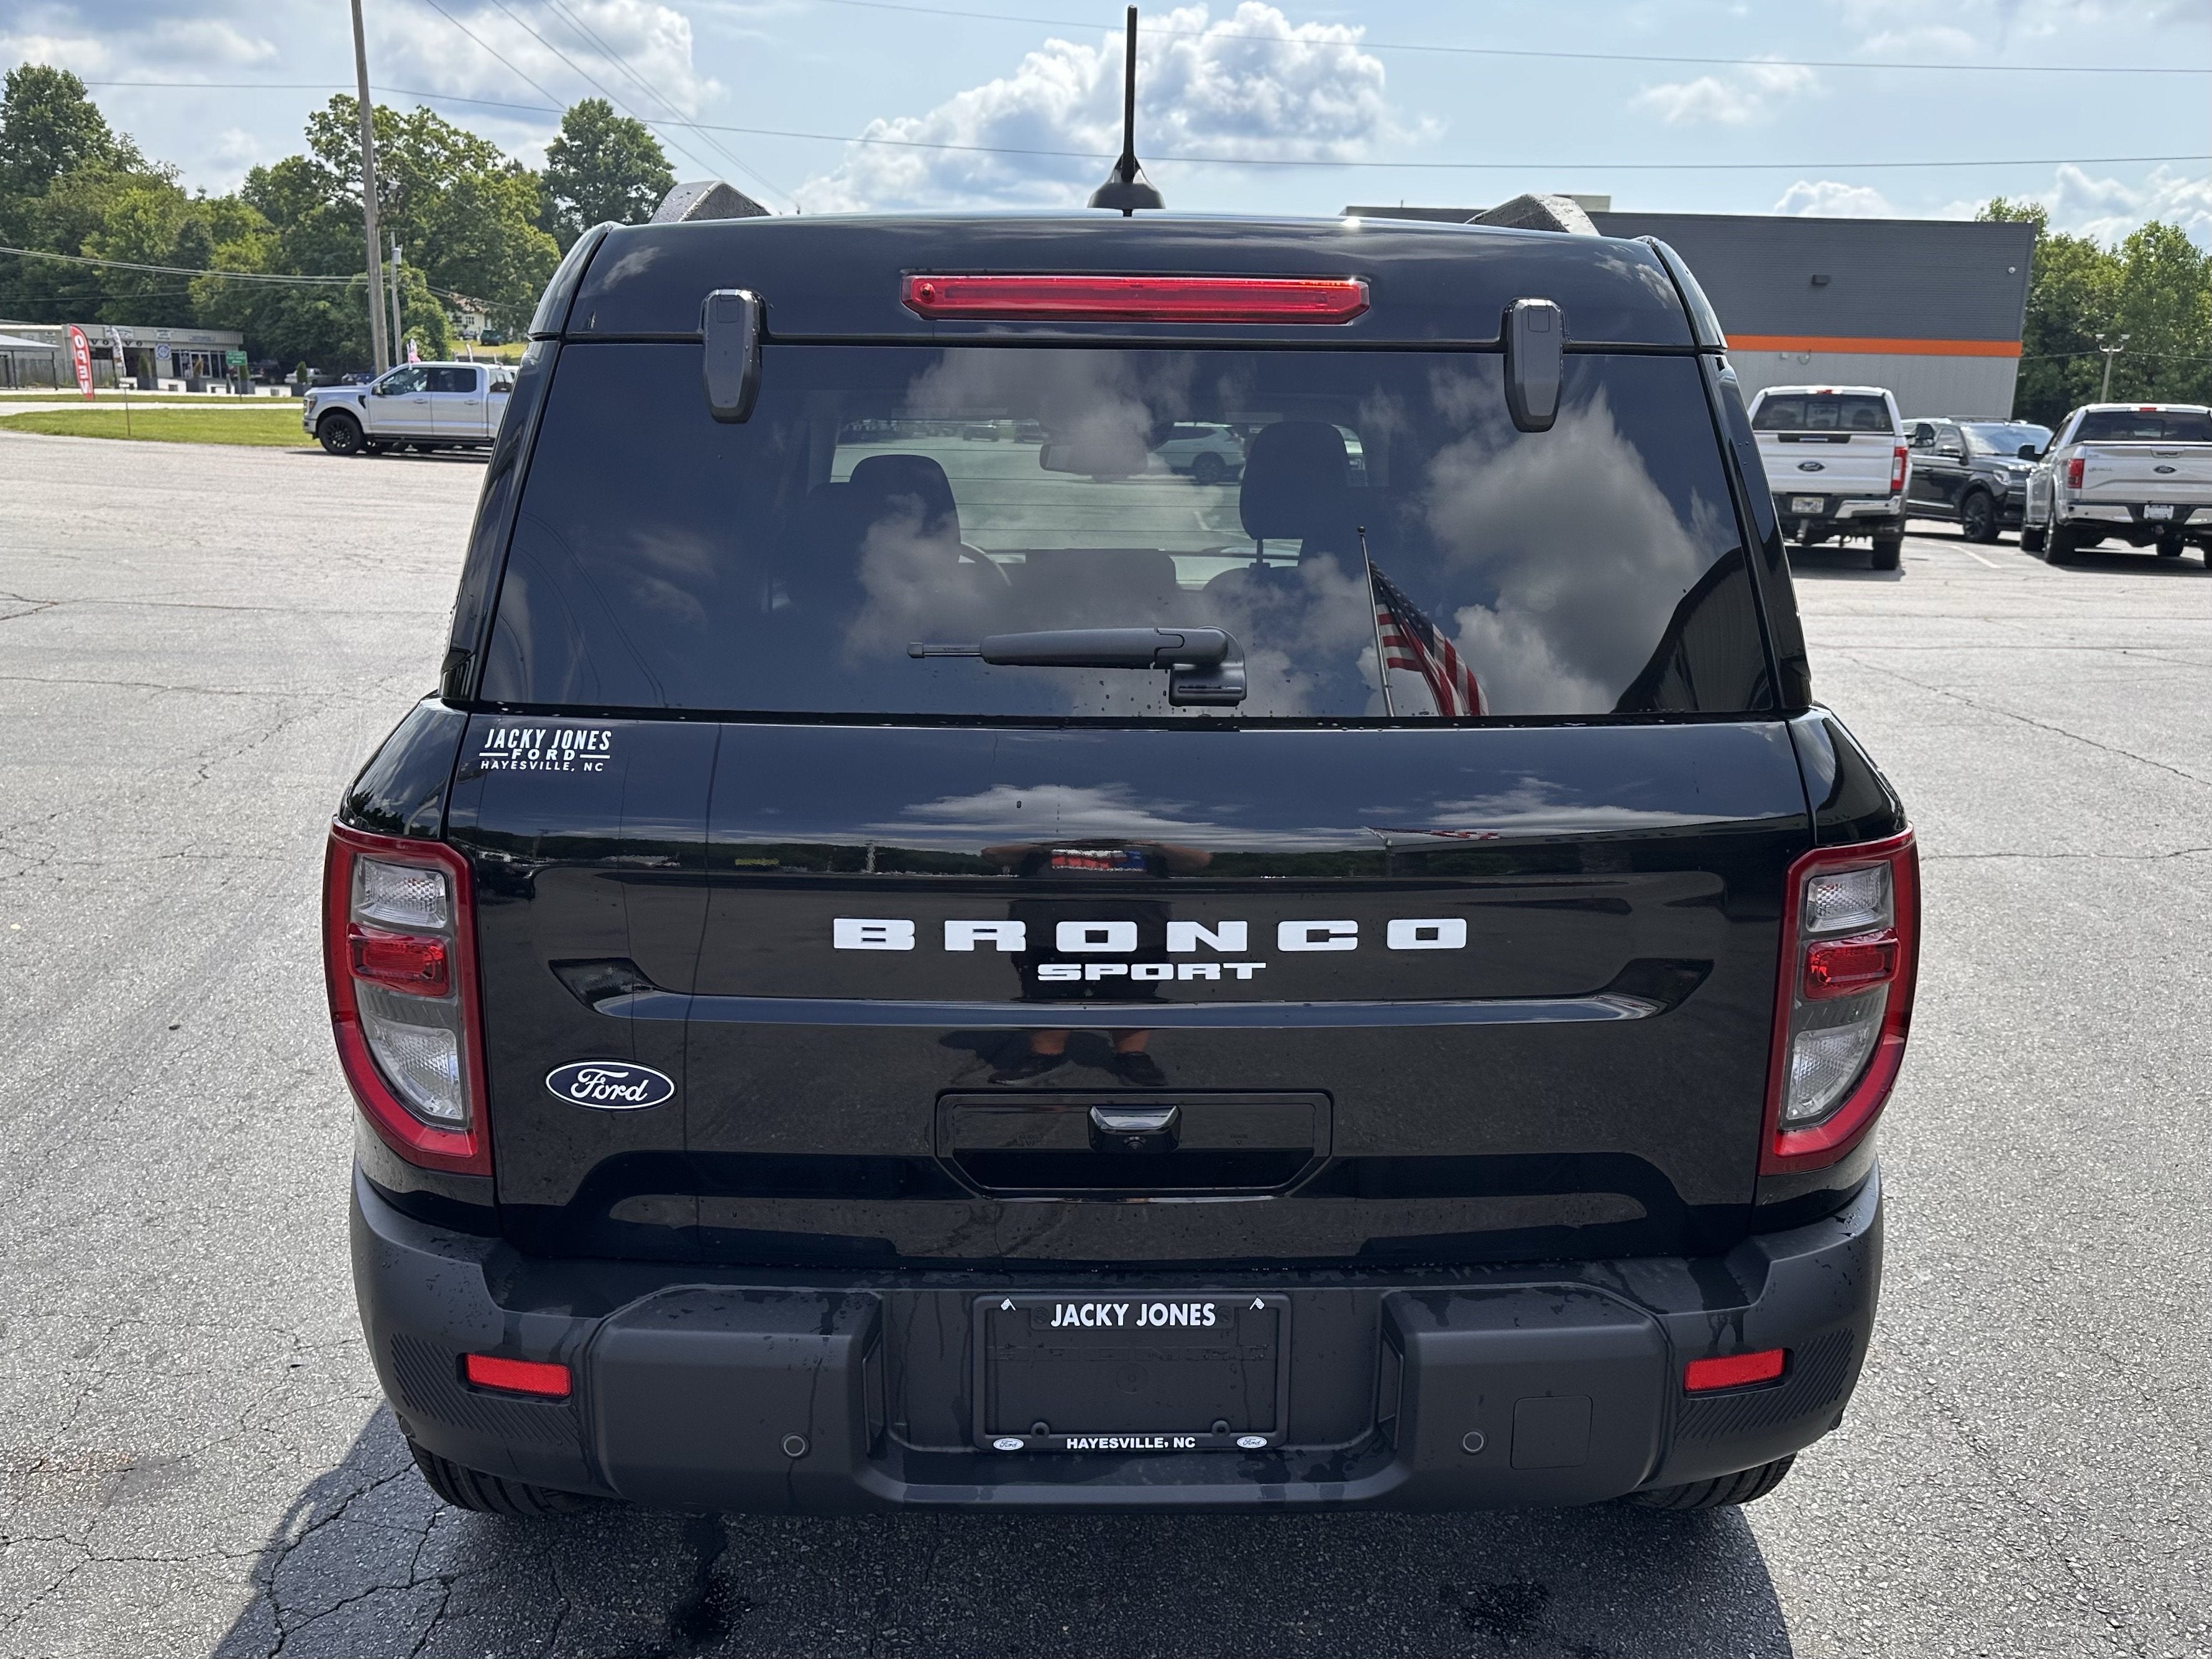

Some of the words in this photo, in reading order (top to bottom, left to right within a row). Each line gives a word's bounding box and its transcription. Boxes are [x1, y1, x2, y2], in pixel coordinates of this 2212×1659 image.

[73, 334, 91, 395] OPEN
[485, 728, 546, 748] JACKY
[551, 729, 612, 750] JONES
[512, 749, 575, 760] FORD
[480, 760, 575, 772] HAYESVILLE,
[584, 762, 603, 771] NC
[833, 918, 1467, 952] BRONCO
[1038, 962, 1266, 981] SPORT
[570, 1068, 649, 1101] Ford
[1050, 1303, 1129, 1327] JACKY
[1136, 1302, 1216, 1326] JONES
[1067, 1437, 1169, 1449] HAYESVILLE,
[1173, 1436, 1196, 1448] NC
